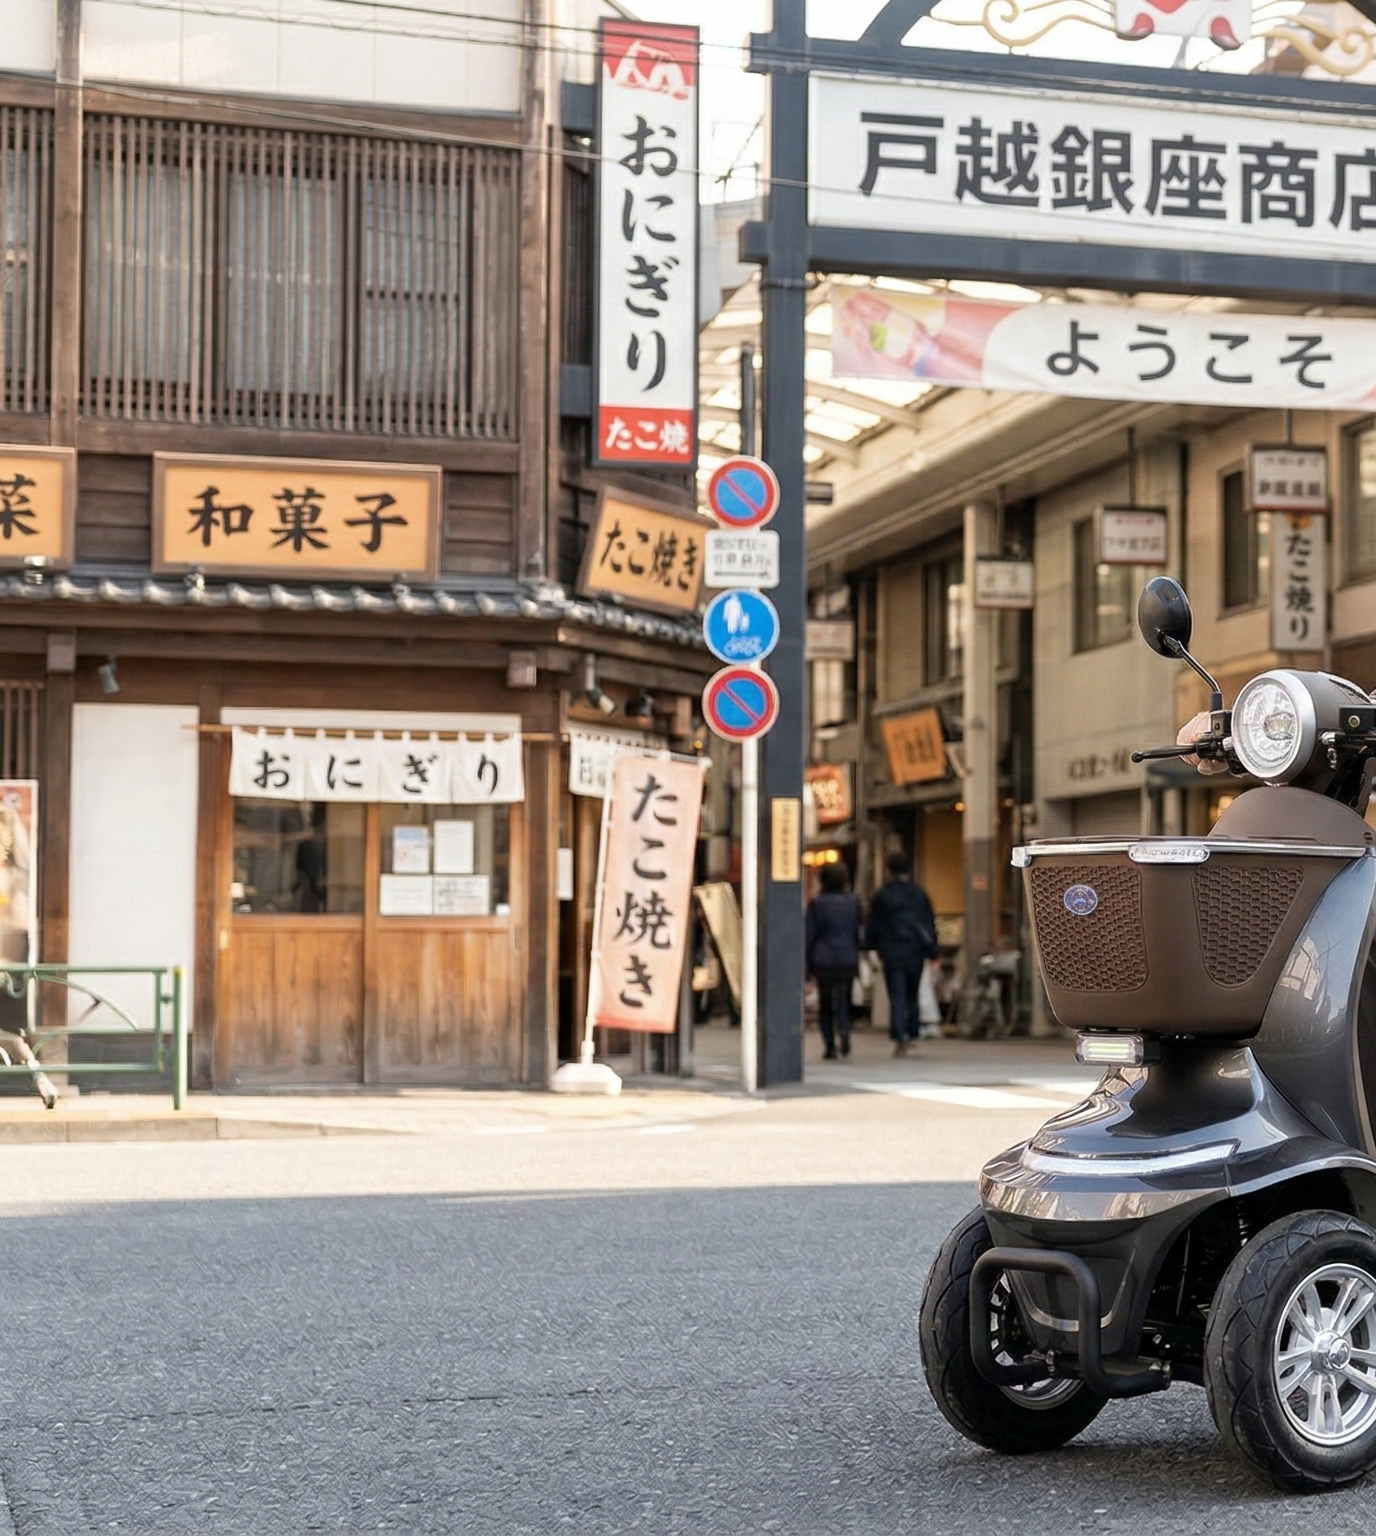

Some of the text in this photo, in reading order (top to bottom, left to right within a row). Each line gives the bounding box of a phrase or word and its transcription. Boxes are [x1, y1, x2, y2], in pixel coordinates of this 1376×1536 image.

[619, 114, 680, 392] おにぎり
[1046, 319, 1336, 390] ようこそ
[188, 484, 408, 553] 和菓子
[599, 517, 697, 592] たこ焼き
[252, 749, 500, 796] おにぎり
[613, 773, 678, 1010] たこ焼き
